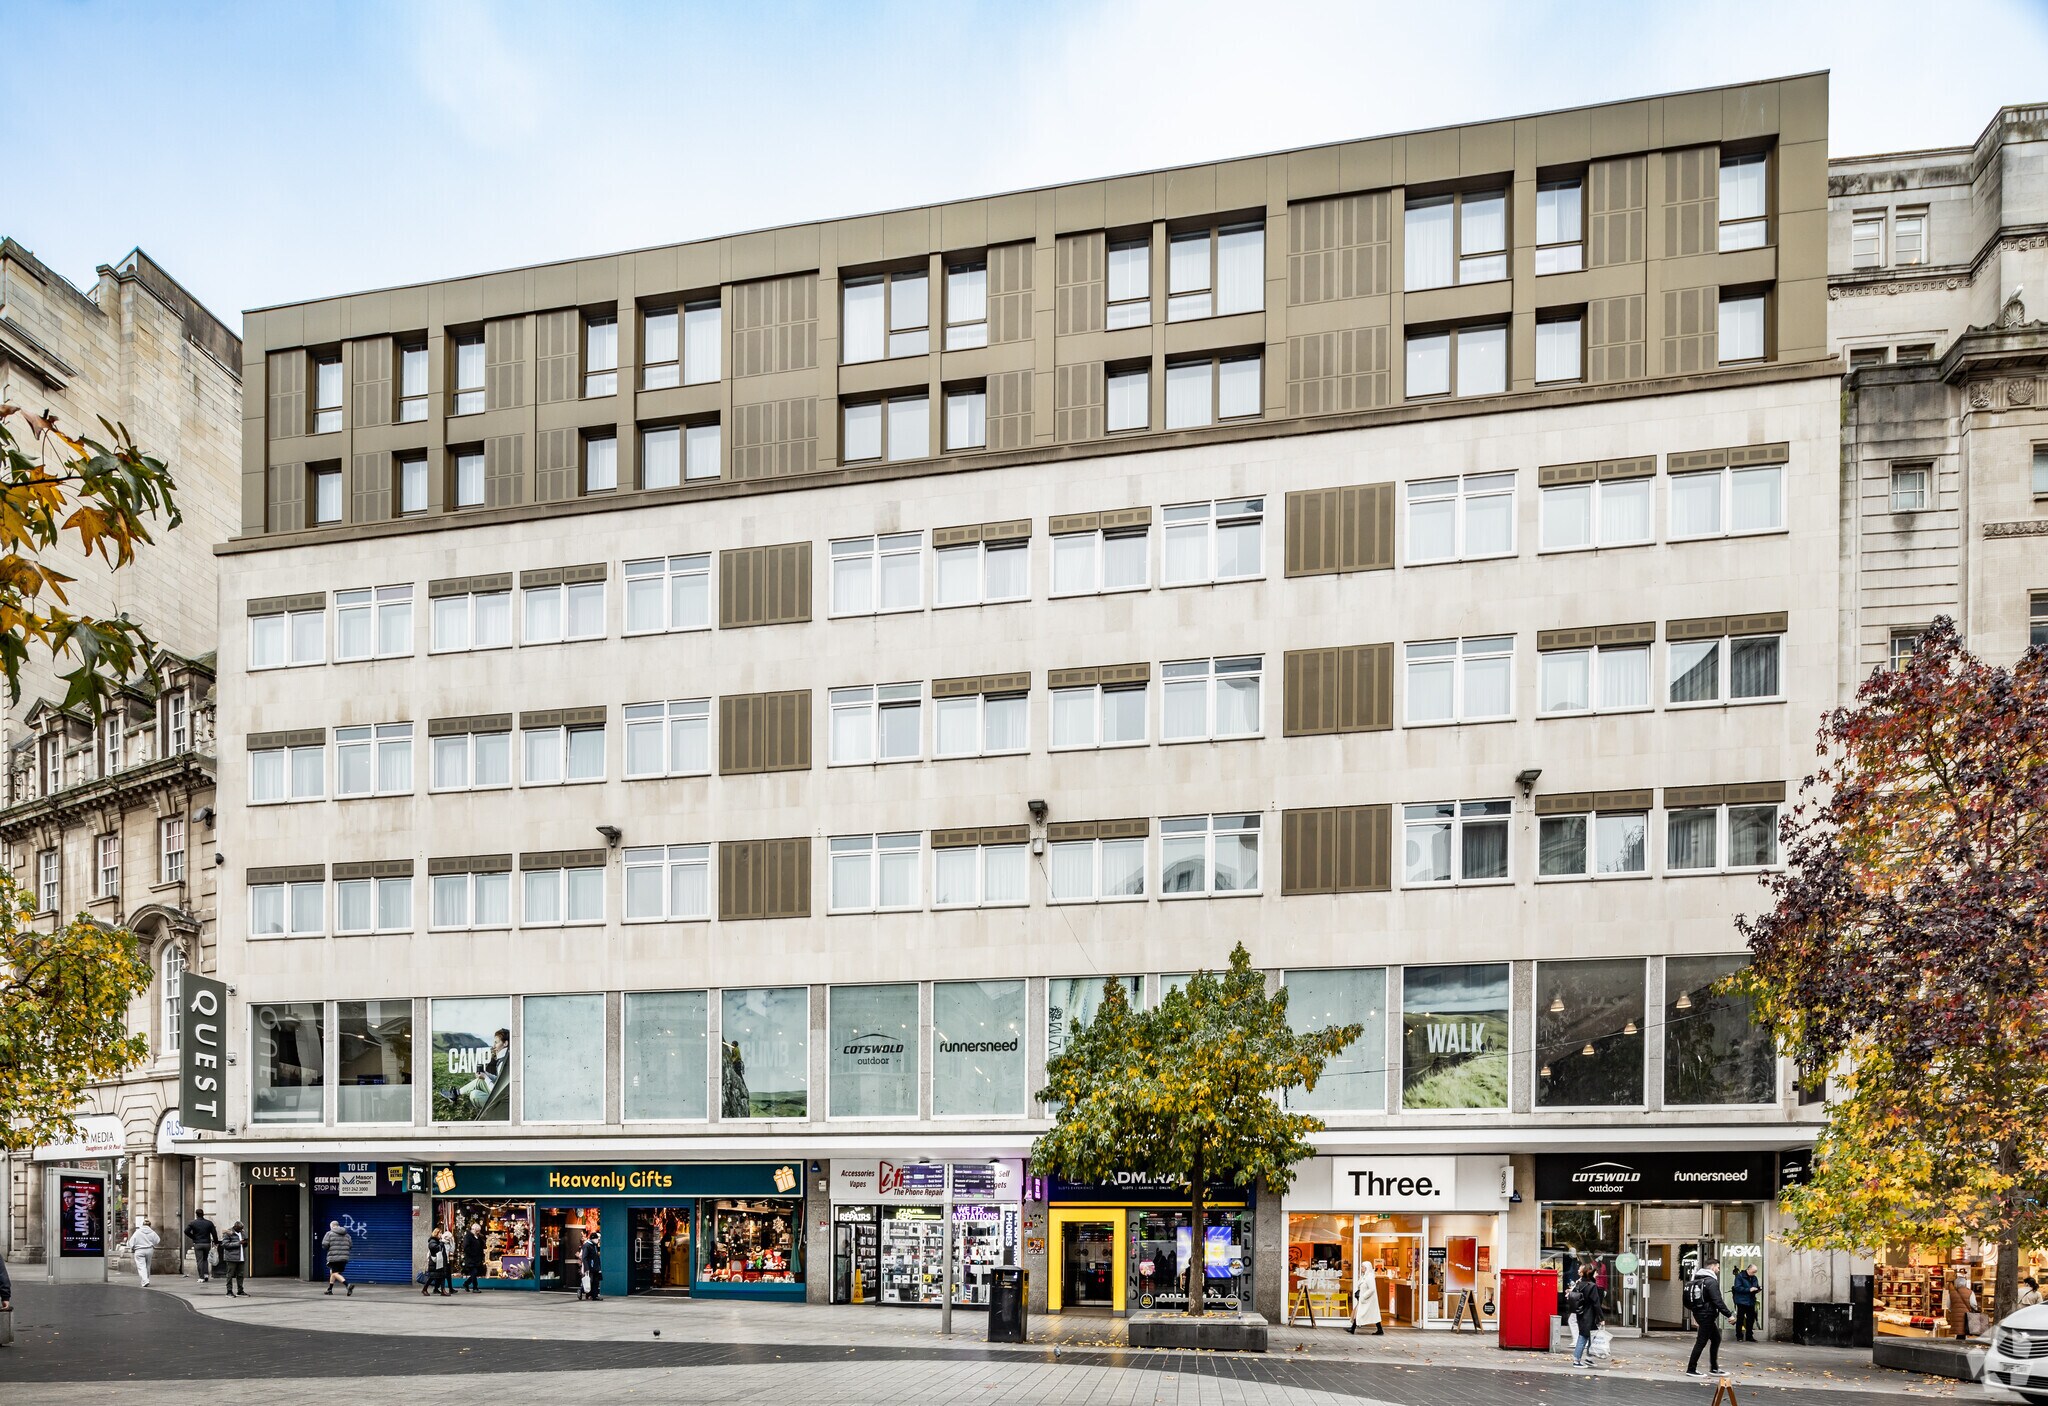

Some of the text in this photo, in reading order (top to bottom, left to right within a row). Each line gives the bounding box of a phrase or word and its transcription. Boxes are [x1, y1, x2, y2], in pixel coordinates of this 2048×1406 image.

[1426, 1022, 1486, 1053] WALK
[843, 1044, 904, 1054] COTSWOLD
[939, 1038, 1018, 1053] runnersneed
[190, 989, 218, 1118] QUEST
[448, 1046, 492, 1074] CAMP
[857, 1057, 889, 1065] outdoor
[90, 1131, 114, 1144] MEDIA
[347, 1163, 368, 1171] TO LET
[251, 1166, 296, 1180] QUEST
[841, 1169, 875, 1177] Accessories
[1571, 1172, 1641, 1182] COTSWOLD
[1674, 1169, 1748, 1182] runnersneed
[314, 1176, 340, 1184] GEEK RET
[549, 1170, 673, 1191] Heavenly Gifts
[849, 1180, 867, 1189] Vapes
[1347, 1170, 1441, 1196] Three.
[992, 1182, 1007, 1190] gets
[1588, 1184, 1624, 1193] outdoor
[893, 1188, 944, 1198] The Phone Repair
[74, 1189, 89, 1236] JACKAL
[957, 1206, 985, 1214] WE FIX
[839, 1212, 871, 1221] REPAIRS
[952, 1212, 999, 1221] AYSTATIONS
[1005, 1211, 1013, 1247] PHONES
[1722, 1245, 1762, 1257] HOKA
[1242, 1222, 1252, 1301] SLOTS
